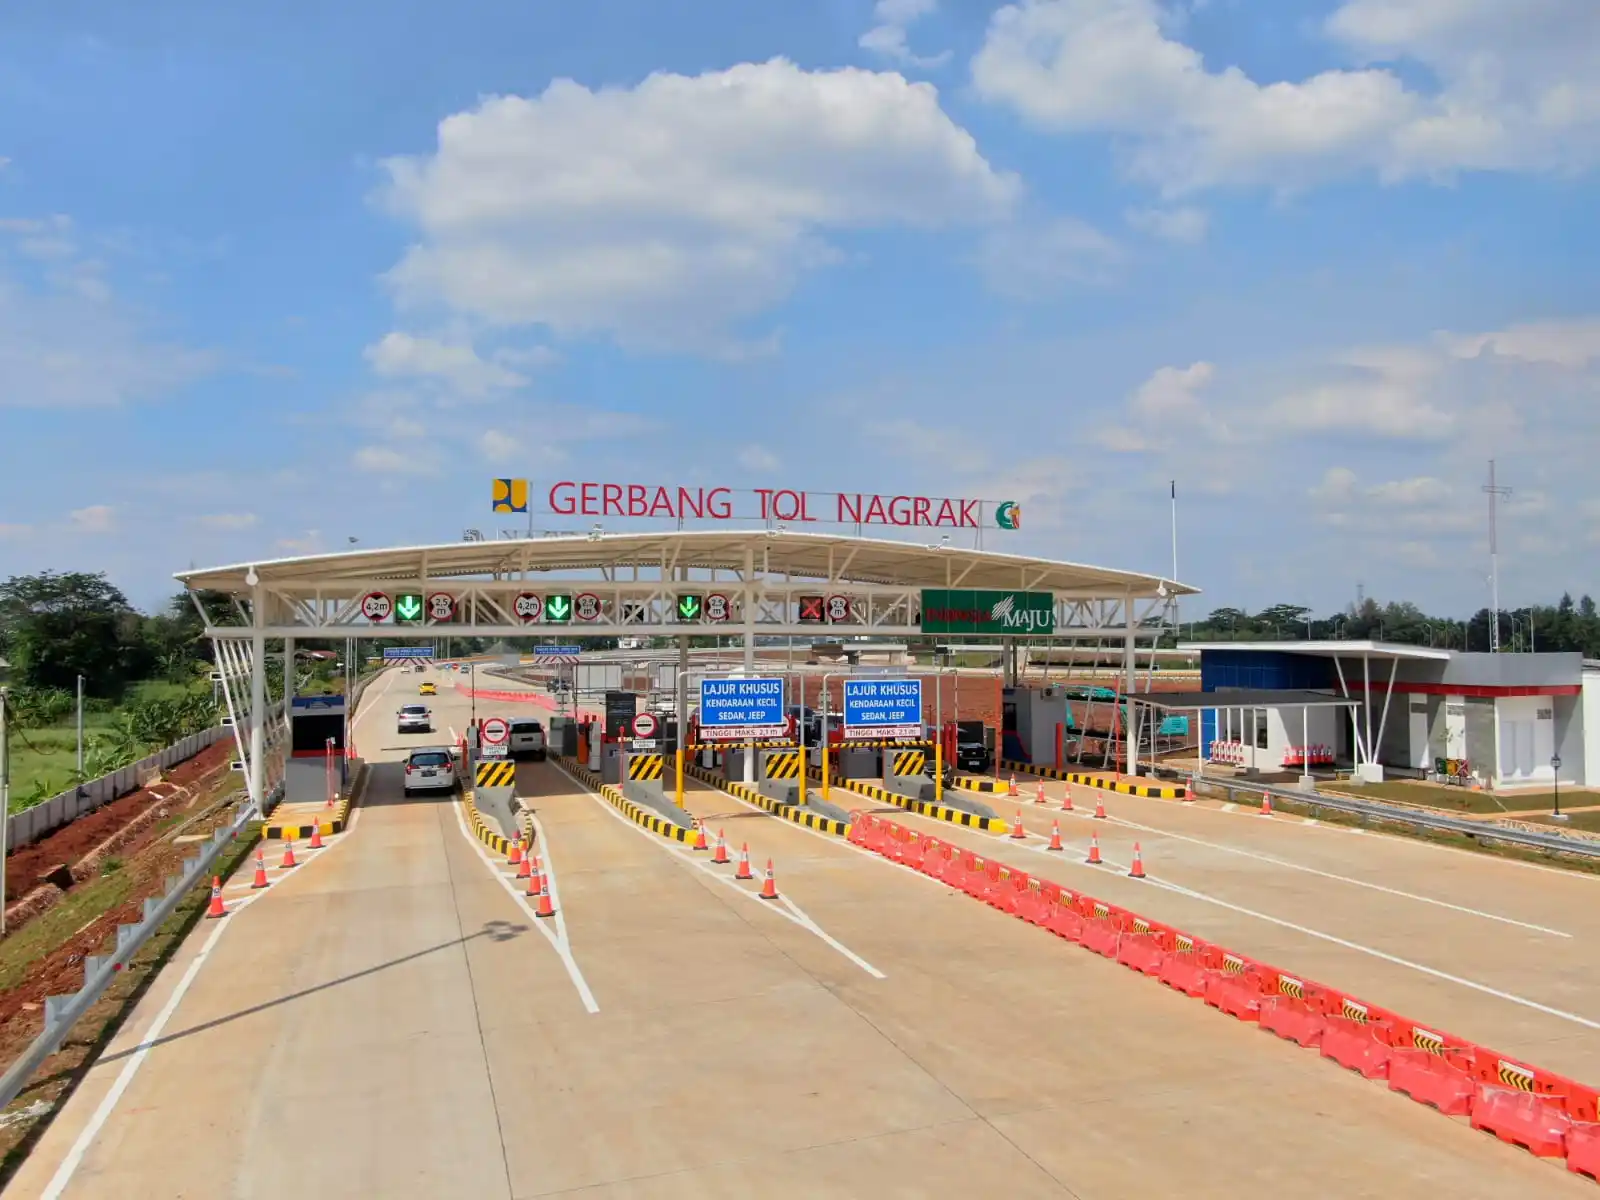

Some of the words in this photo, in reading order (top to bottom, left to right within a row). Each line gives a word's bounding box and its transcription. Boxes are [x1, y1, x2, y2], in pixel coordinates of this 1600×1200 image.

[549, 481, 732, 519] GERBANG
[753, 489, 817, 521] TOL
[837, 493, 978, 528] NAGRAK
[366, 602, 388, 611] 4,2m
[517, 602, 538, 611] 4,2m
[1003, 609, 1050, 632] MAJU
[703, 683, 736, 695] LAJUR
[739, 682, 780, 695] KHUSUS
[847, 685, 878, 696] LAJUR
[880, 684, 919, 696] KHUSUS
[705, 698, 754, 708] KENDARAAN
[756, 698, 777, 707] KECIL
[849, 700, 894, 709] KENDARAAN
[896, 699, 915, 708] KECIL
[718, 711, 747, 721] SEDAN,
[748, 711, 766, 720] JEEP
[888, 711, 904, 720] JEEP
[705, 729, 732, 737] TINGGI
[848, 729, 872, 737] TINGGI
